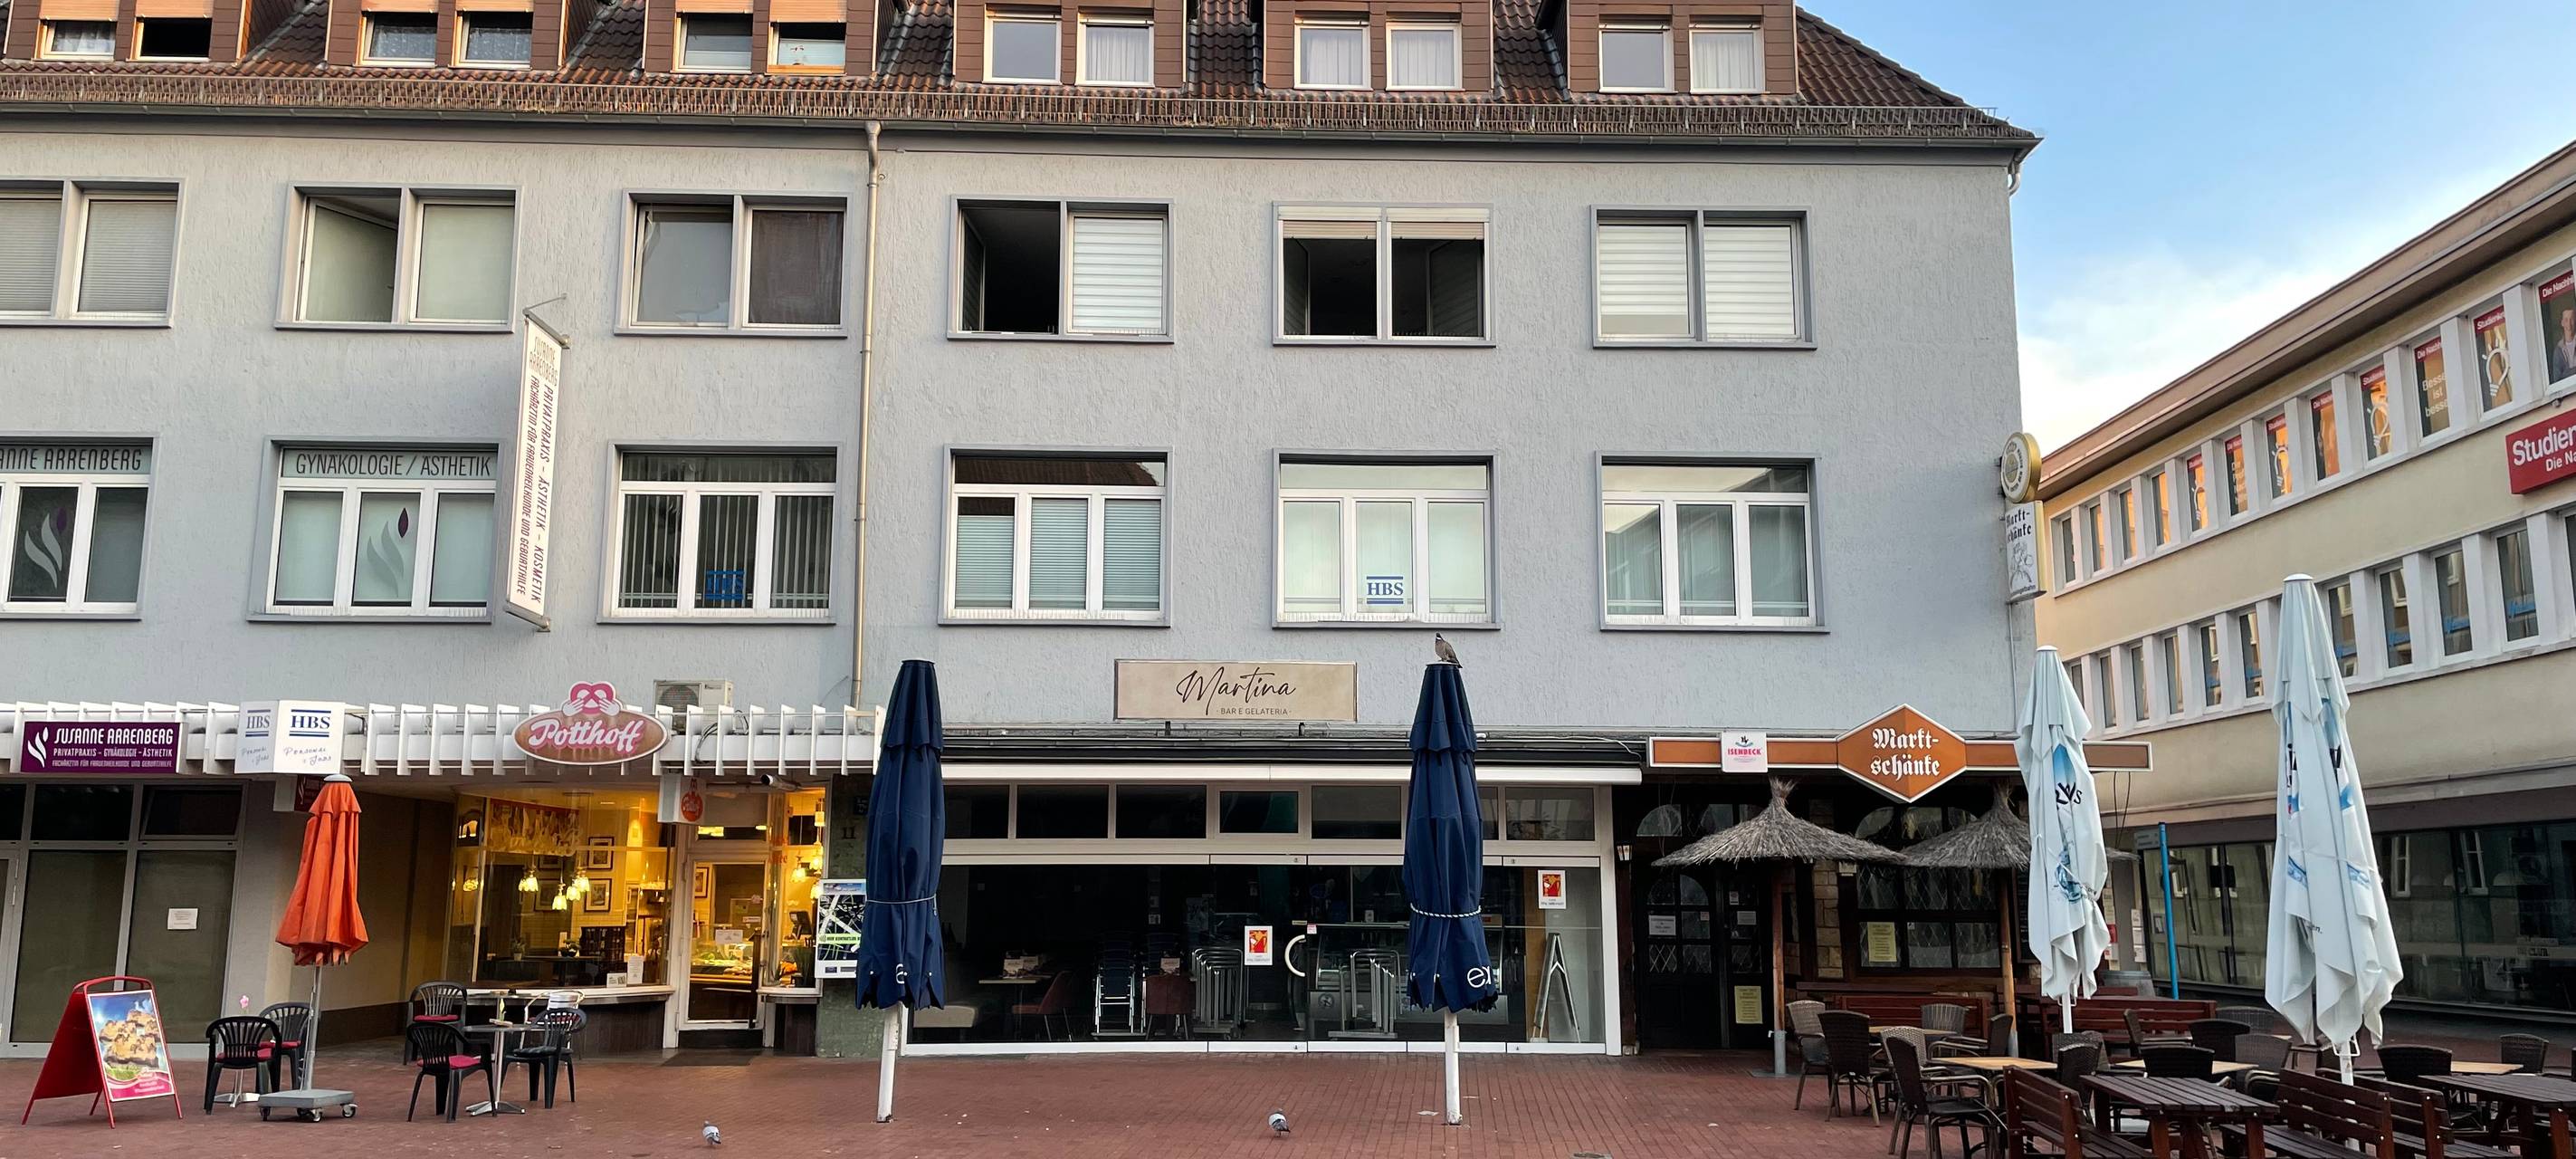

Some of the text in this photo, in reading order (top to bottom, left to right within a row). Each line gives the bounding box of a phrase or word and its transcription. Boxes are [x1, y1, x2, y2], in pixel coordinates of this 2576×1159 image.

[528, 375, 540, 426] FACHÄRZTIN
[539, 384, 554, 463] PRIVATPRAXIS
[43, 448, 142, 471] ARRENBERG
[296, 453, 404, 475] GYNÄKOLOGIE
[420, 455, 491, 477] ÄSTHETIK
[2545, 456, 2563, 472] Die
[521, 442, 536, 518] FRAUENHEILKUNDE
[536, 475, 550, 532] ÄSTHETIK
[520, 518, 531, 537] UND
[517, 536, 530, 597] GEBURTSHILFE
[531, 545, 544, 604] KOSMETIK
[1367, 582, 1404, 596] HBS
[1176, 666, 1296, 715] Martina
[246, 715, 271, 730] HBS
[291, 715, 331, 730] HBS
[1220, 707, 1237, 715] BAR
[54, 728, 174, 745] SUSANNE ARRENBERG
[528, 718, 644, 753] Potthoff
[1872, 727, 1940, 750] Markt-
[53, 747, 97, 757] PRIVATPRAXIS
[142, 746, 173, 757] ÄSTHETIK
[1870, 753, 1940, 781] schänke
